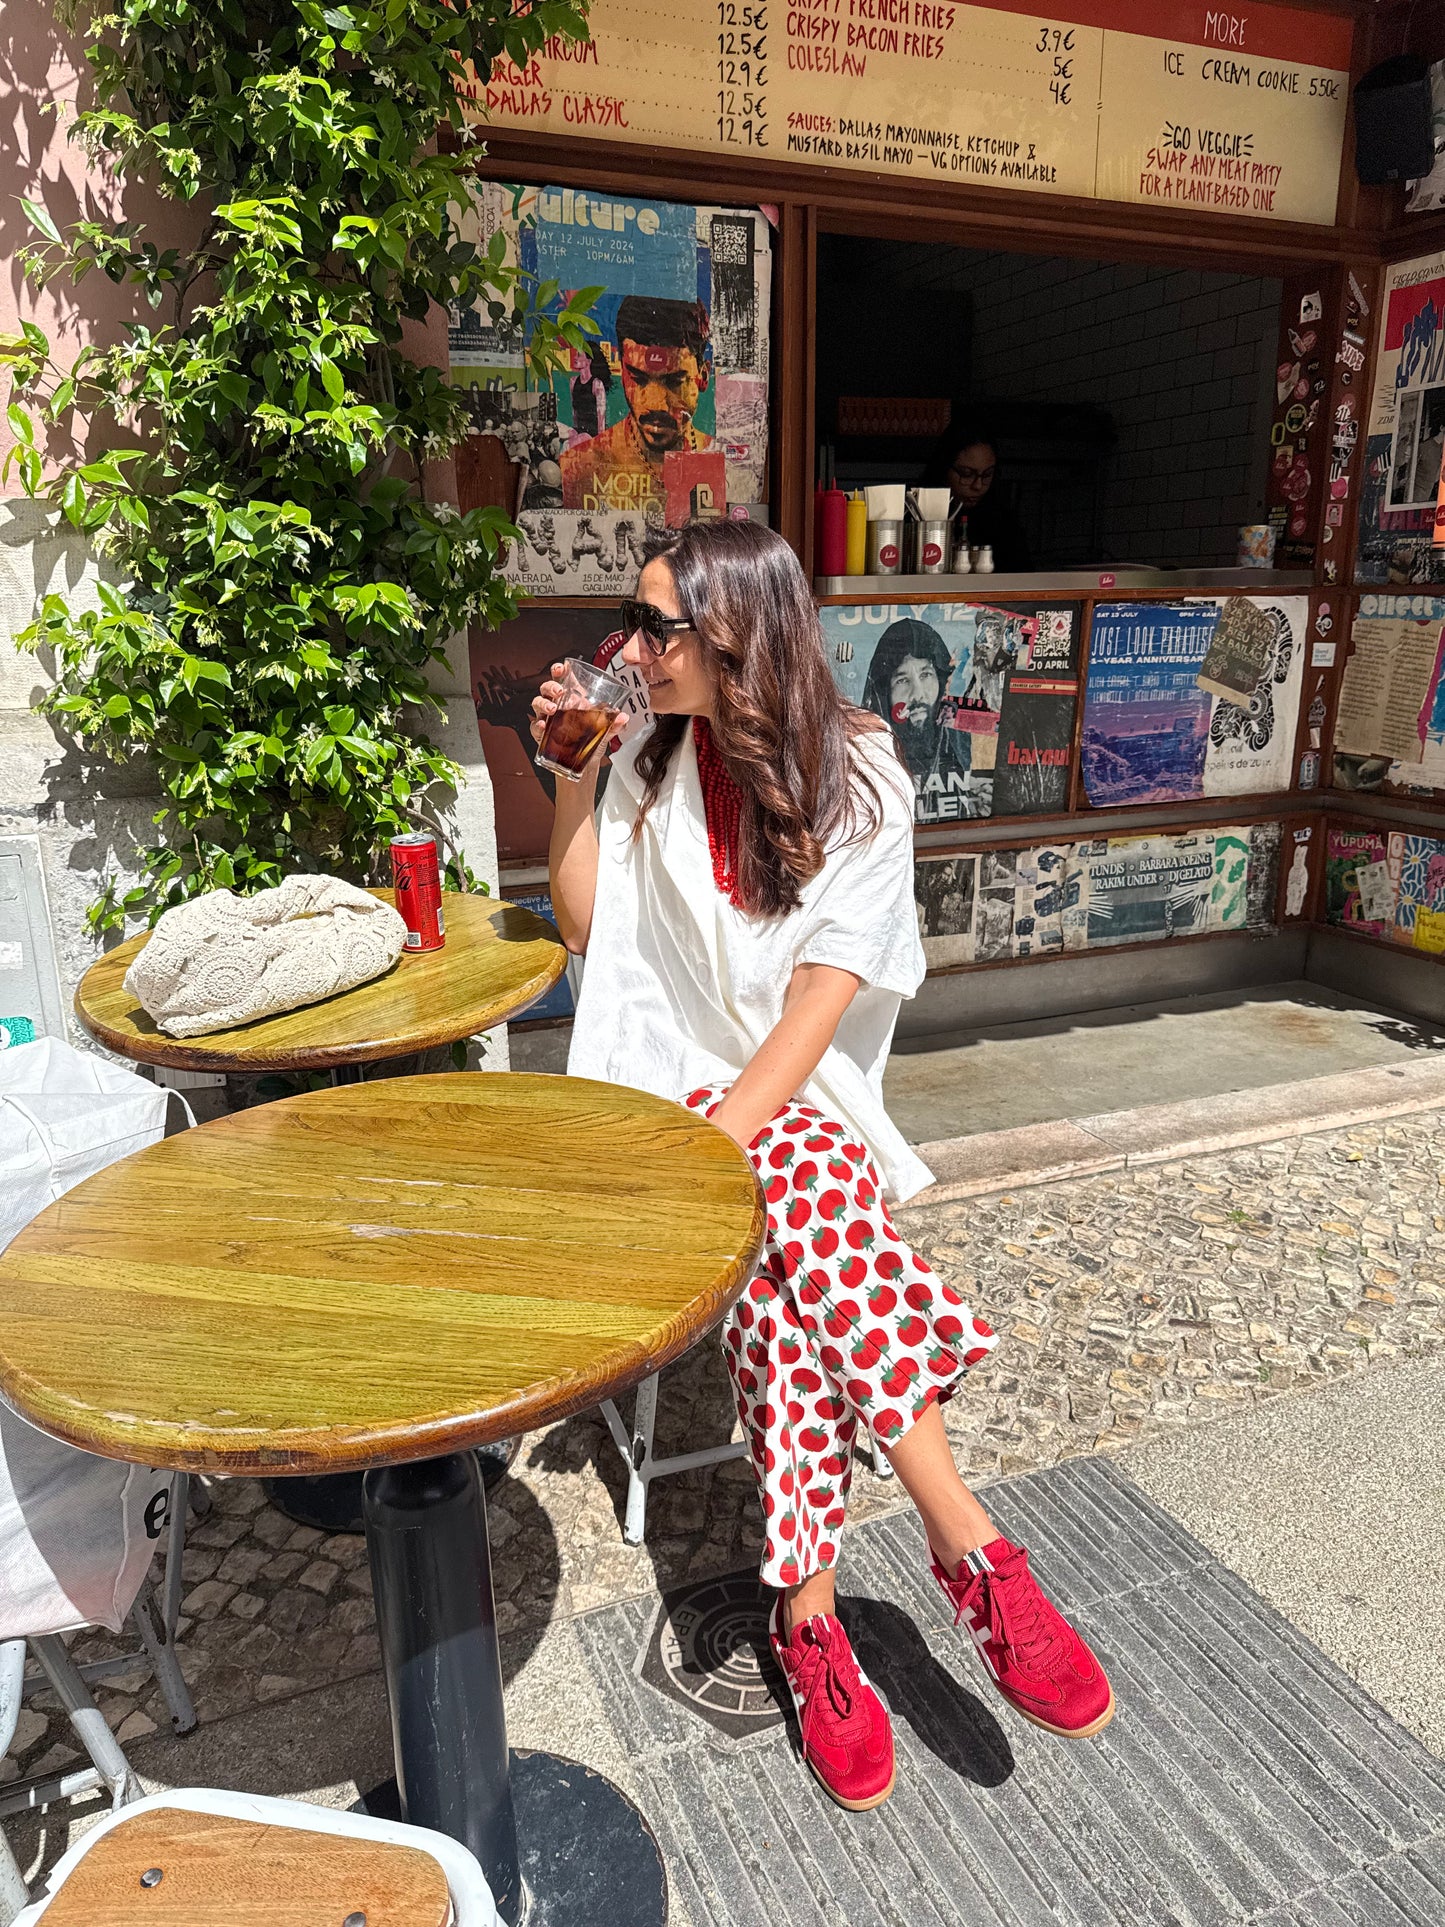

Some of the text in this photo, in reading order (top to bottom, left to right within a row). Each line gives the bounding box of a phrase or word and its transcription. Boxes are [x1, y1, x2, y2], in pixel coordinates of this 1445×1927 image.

[717, 2, 768, 30] 12.5€
[915, 3, 956, 31] FRIES
[1204, 11, 1247, 46] MORE
[717, 32, 767, 60] 12.5€
[786, 12, 944, 59] CRISPY BACON FRIES
[1036, 28, 1076, 53] 3.9€
[787, 44, 867, 77] COLESLAW
[1053, 56, 1074, 79] 5€
[1163, 51, 1185, 76] ICE
[1202, 59, 1250, 86] CREAM
[1257, 70, 1300, 93] COOKIE
[717, 90, 767, 118] 12.5€
[1049, 80, 1072, 105] 4€
[486, 88, 552, 115] DALLAS
[563, 95, 629, 128] CLASSIC
[717, 117, 769, 147] 12.9€
[787, 112, 836, 133] SAUCES:
[886, 124, 963, 152] MAYONNAISE,
[967, 135, 1020, 158] KETCHUP
[1173, 125, 1243, 158] GO VEGGIE
[846, 142, 880, 161] BASIL
[883, 146, 913, 165] MAYO
[931, 150, 947, 169] VG
[952, 154, 997, 175] OPTIONS
[1001, 161, 1057, 183] AVAILABLE
[1146, 148, 1282, 187] SWAP ANY MEAT PATTY
[1140, 173, 1161, 197] FOR
[1163, 177, 1173, 198] A
[1253, 189, 1276, 212] ONE
[560, 234, 572, 244] 12
[578, 236, 603, 247] JULY
[611, 240, 634, 250] 2024
[587, 251, 635, 265] 10PM/6AM
[593, 472, 654, 497] MOTEL
[522, 573, 539, 583] ERA
[541, 574, 554, 583] DA
[583, 573, 592, 583] 15
[593, 573, 604, 583] DE
[605, 573, 625, 583] MAIO
[583, 583, 622, 593] GAGLIANO
[1091, 626, 1121, 656] JUST
[1044, 660, 1070, 670] APRIL
[1090, 655, 1207, 665] 1-YEAR ANNIVERSAR
[1096, 875, 1126, 890] RAKIM
[1127, 873, 1158, 887] UNDER
[667, 1610, 697, 1662] EPAL
